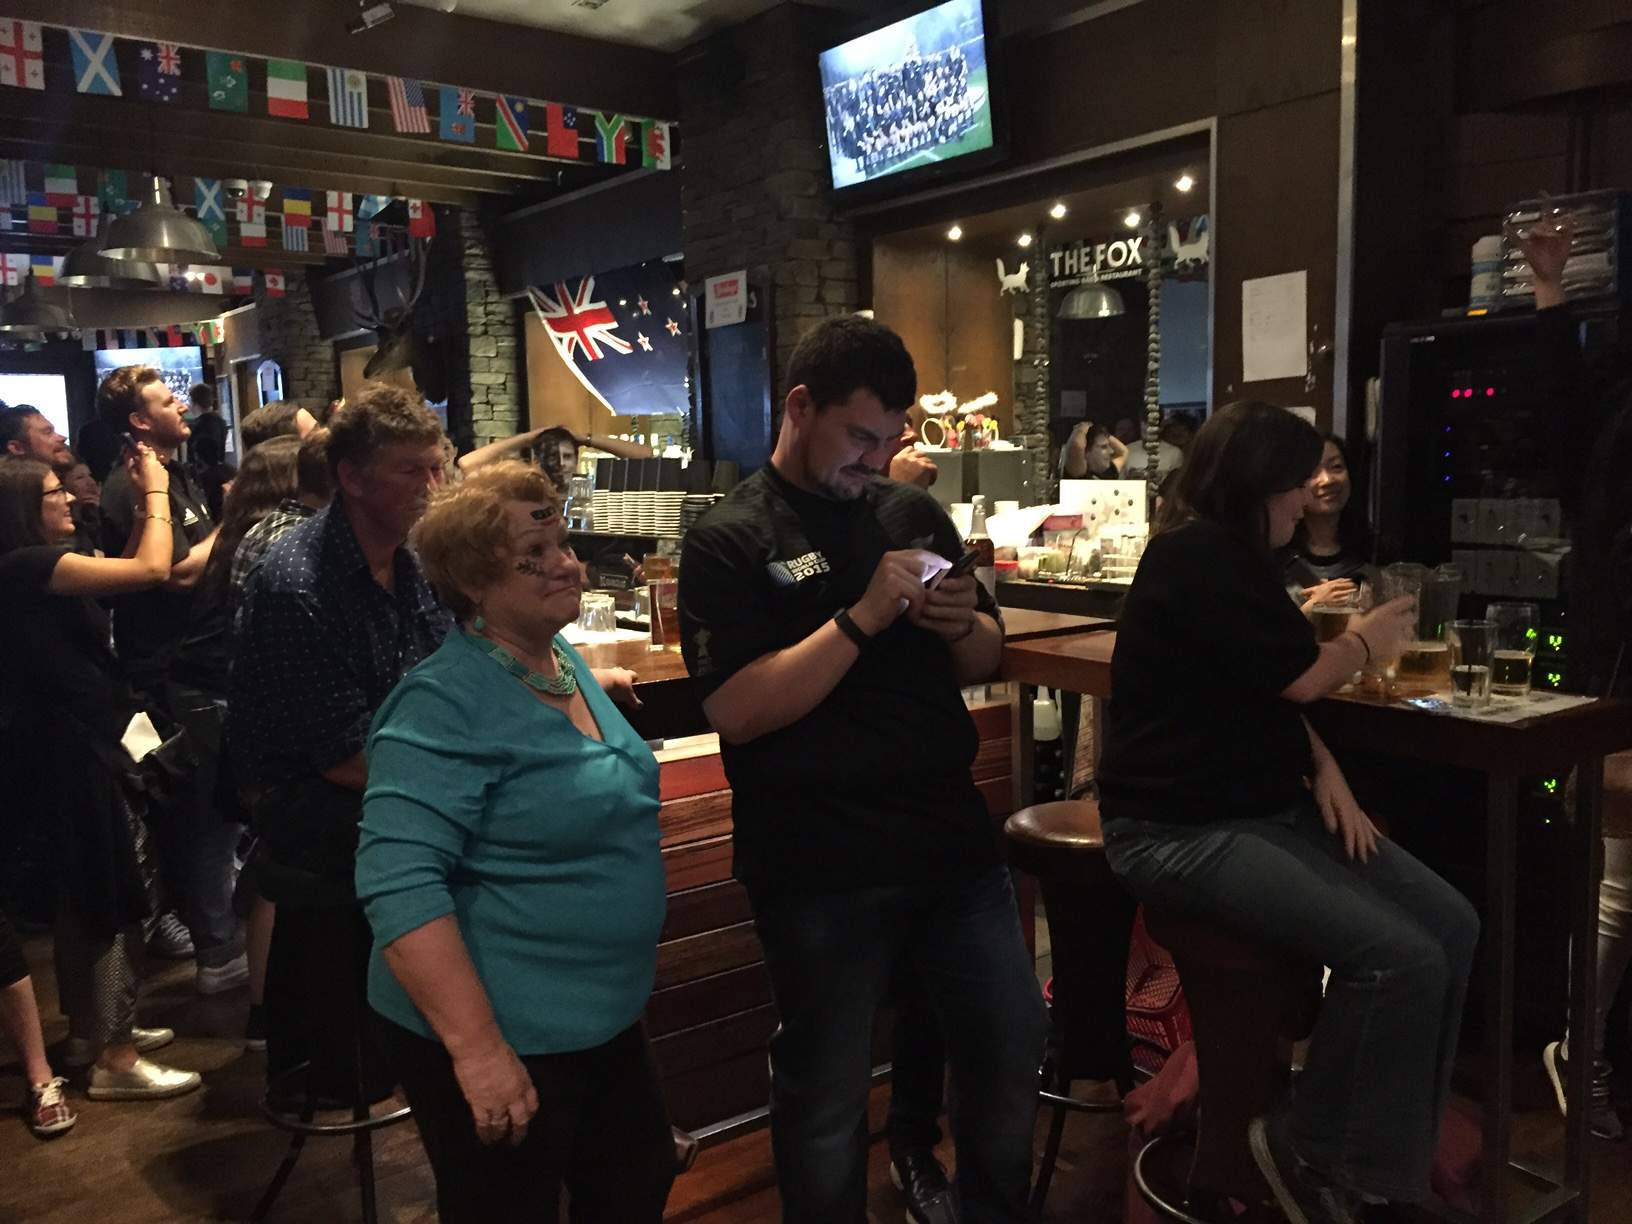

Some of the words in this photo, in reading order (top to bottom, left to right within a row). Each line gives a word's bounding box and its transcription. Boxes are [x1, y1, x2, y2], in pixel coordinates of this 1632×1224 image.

[1050, 246, 1092, 277] THE
[1095, 237, 1143, 270] FOX
[1100, 269, 1142, 280] RESTAURANT
[786, 551, 822, 570] RUGBY
[793, 562, 831, 582] 2015
